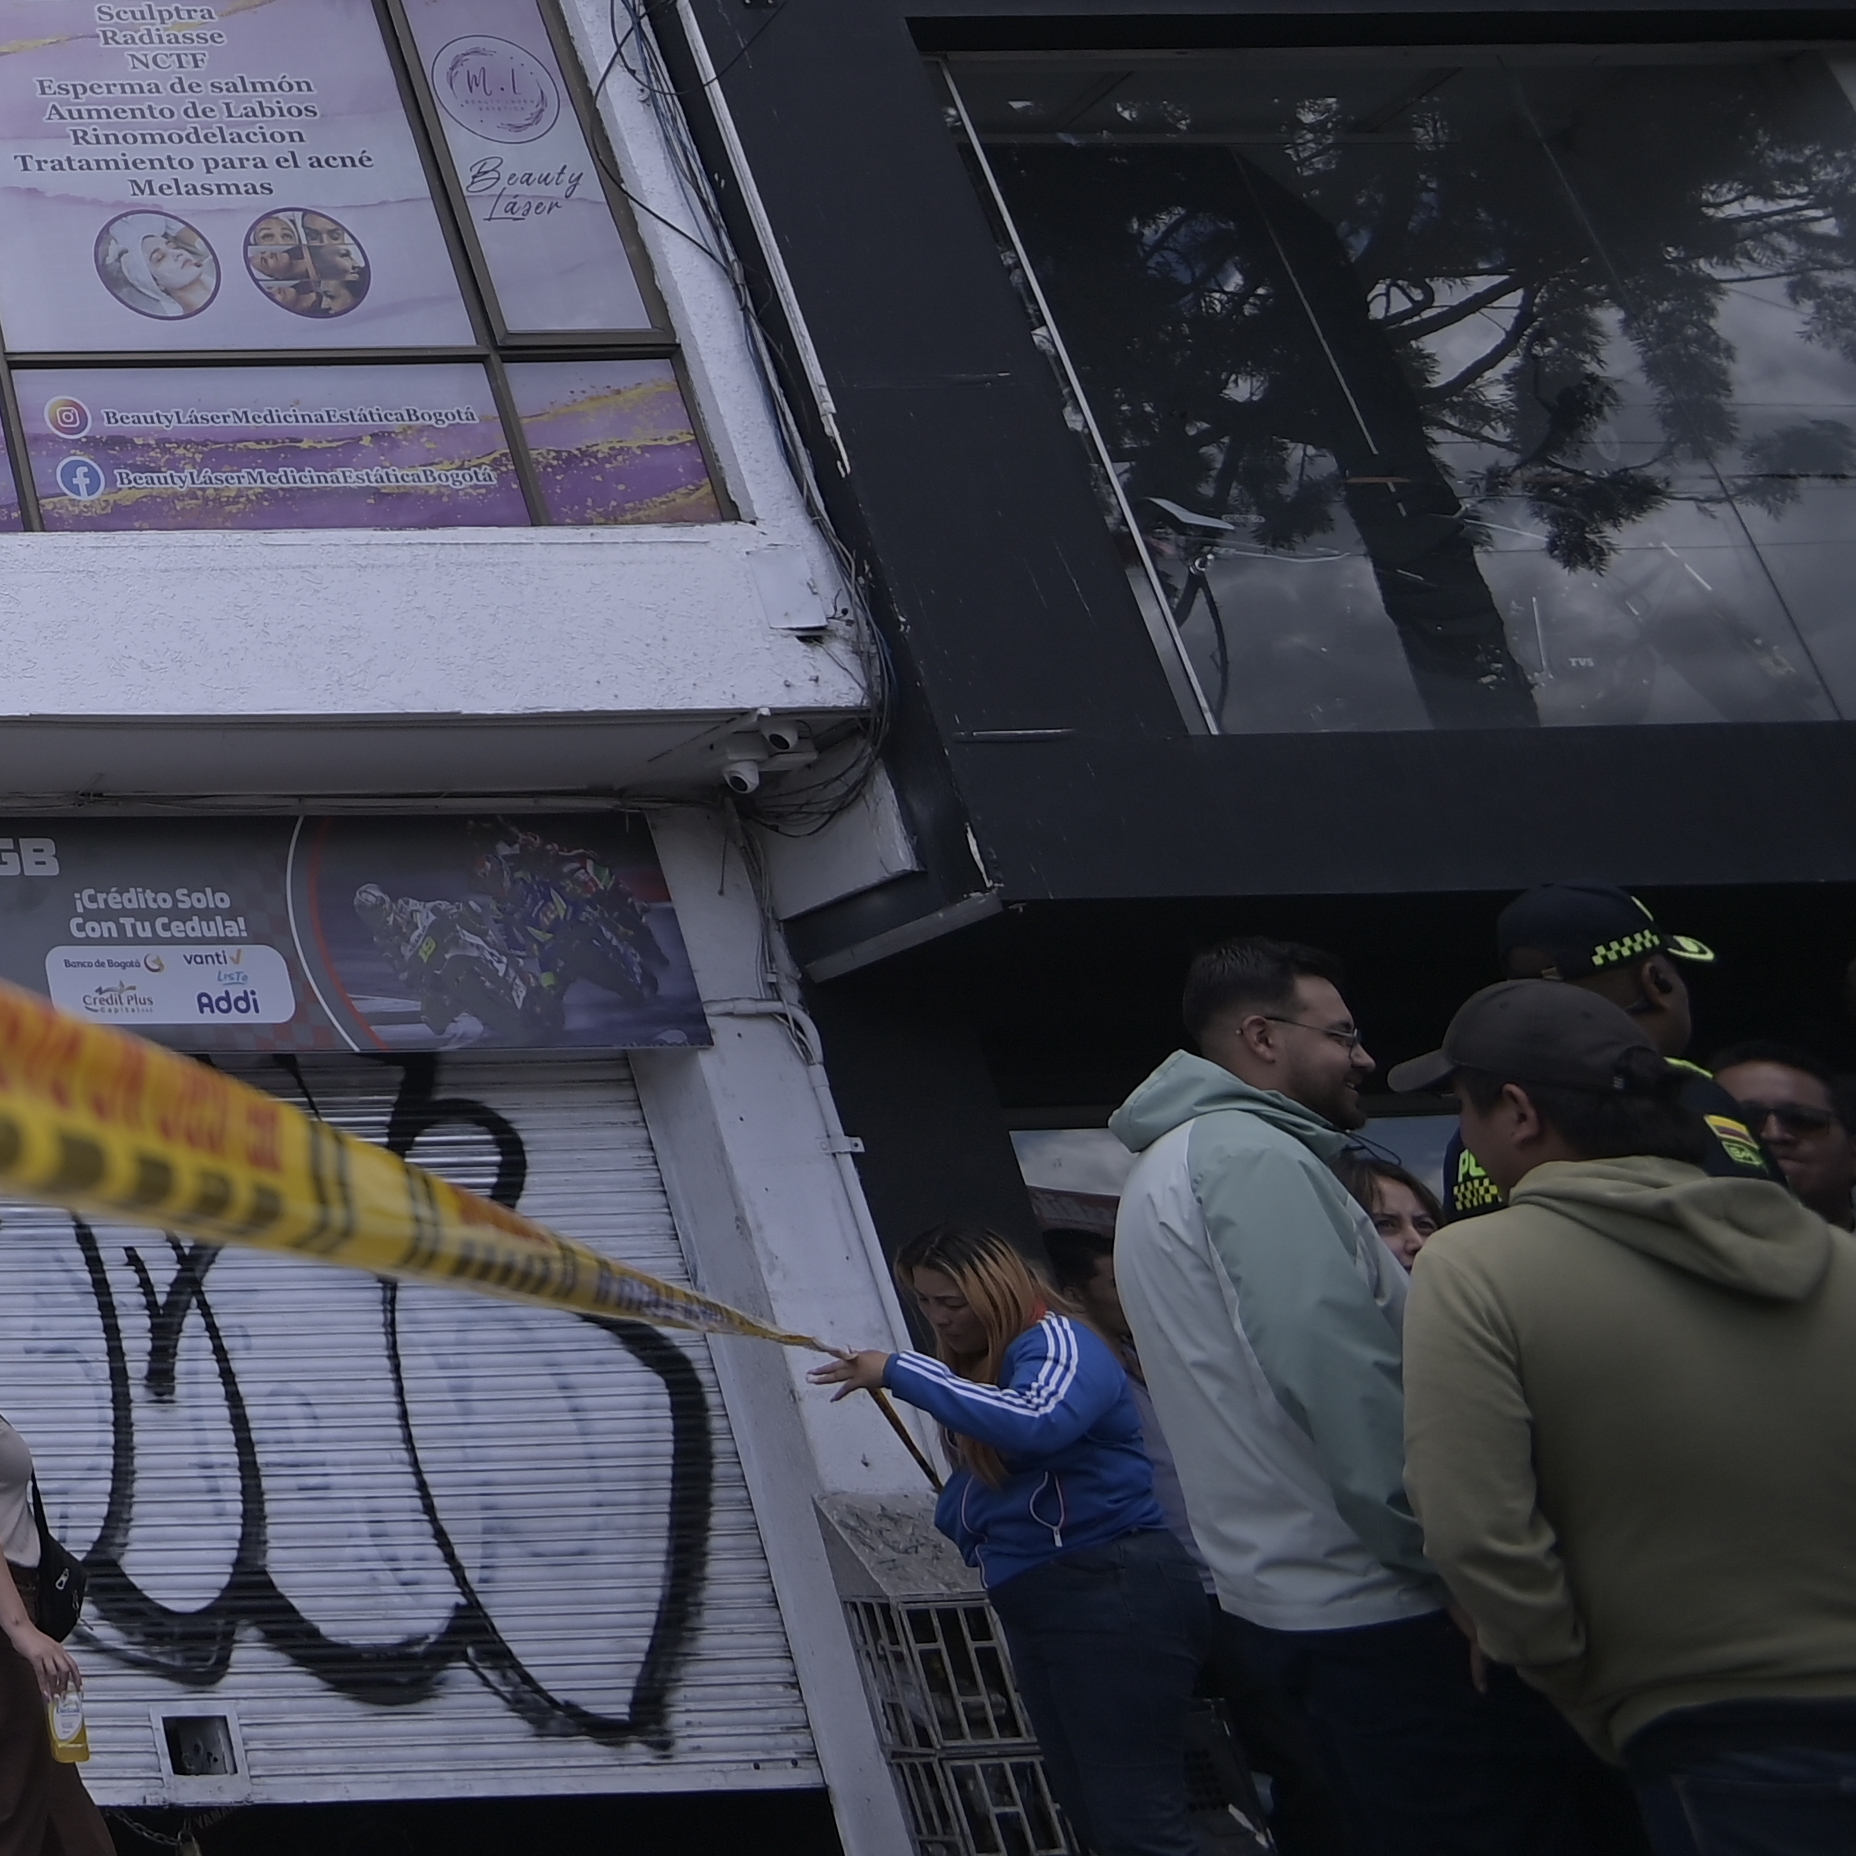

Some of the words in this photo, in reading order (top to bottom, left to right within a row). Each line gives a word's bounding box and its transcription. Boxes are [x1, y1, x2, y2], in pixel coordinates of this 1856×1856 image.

[95, 3, 215, 27] Sculptra
[99, 27, 226, 47] Radiasse
[129, 52, 207, 72] NCTF
[37, 78, 163, 102] Esperma
[170, 76, 203, 96] de
[210, 73, 314, 95] salmón
[45, 102, 175, 122] Aumento
[182, 100, 218, 120] de
[223, 99, 319, 119] Labios
[71, 125, 306, 146] Rinomodelacion
[14, 152, 195, 174] Tratamiento
[202, 154, 267, 175] para
[274, 150, 300, 170] el
[306, 149, 374, 170] acné
[129, 177, 274, 197] Melasmas
[466, 155, 584, 199] Beauty
[483, 186, 563, 222] Láser
[73, 887, 173, 913] ¡Crédito
[174, 886, 231, 909] Solo
[69, 916, 118, 938] Con
[118, 916, 152, 938] Tu
[154, 915, 248, 937] Cedula!
[63, 958, 94, 969] Banco
[94, 958, 106, 968] de
[106, 957, 141, 970] Bogotá
[182, 949, 228, 965] vanti
[126, 993, 154, 1006] Plus
[196, 989, 260, 1014] Addi
